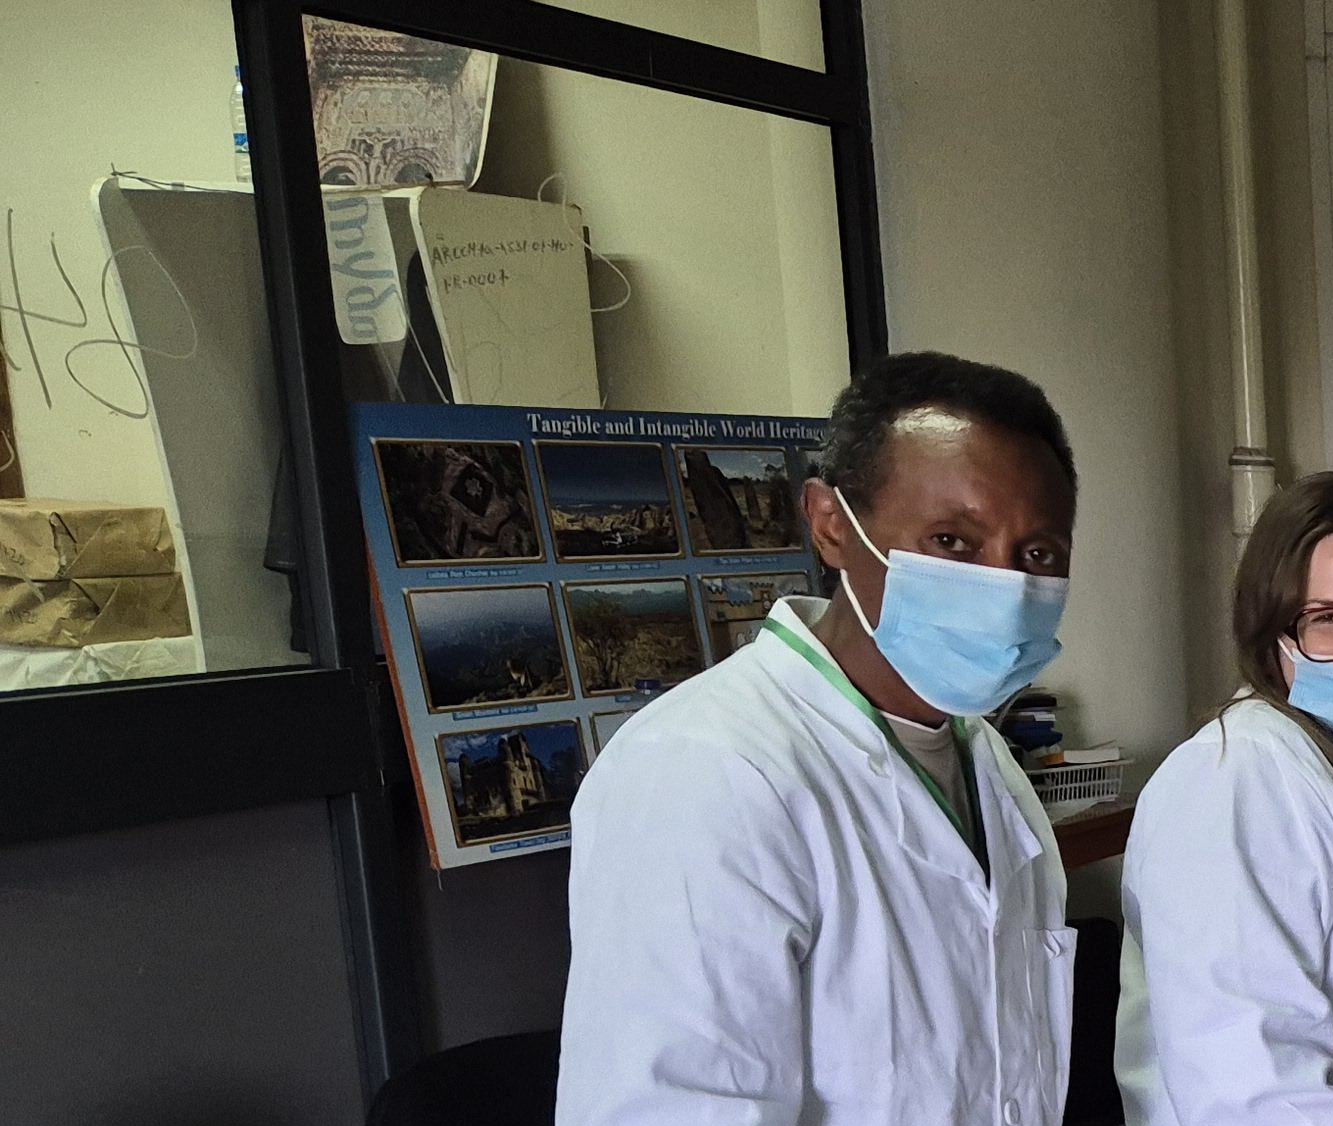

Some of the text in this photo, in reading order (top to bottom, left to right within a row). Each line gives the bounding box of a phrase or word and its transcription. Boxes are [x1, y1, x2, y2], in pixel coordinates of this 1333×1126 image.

[527, 413, 600, 438] Tangible
[605, 416, 634, 436] and
[638, 416, 716, 441] Intangible
[720, 419, 765, 439] World
